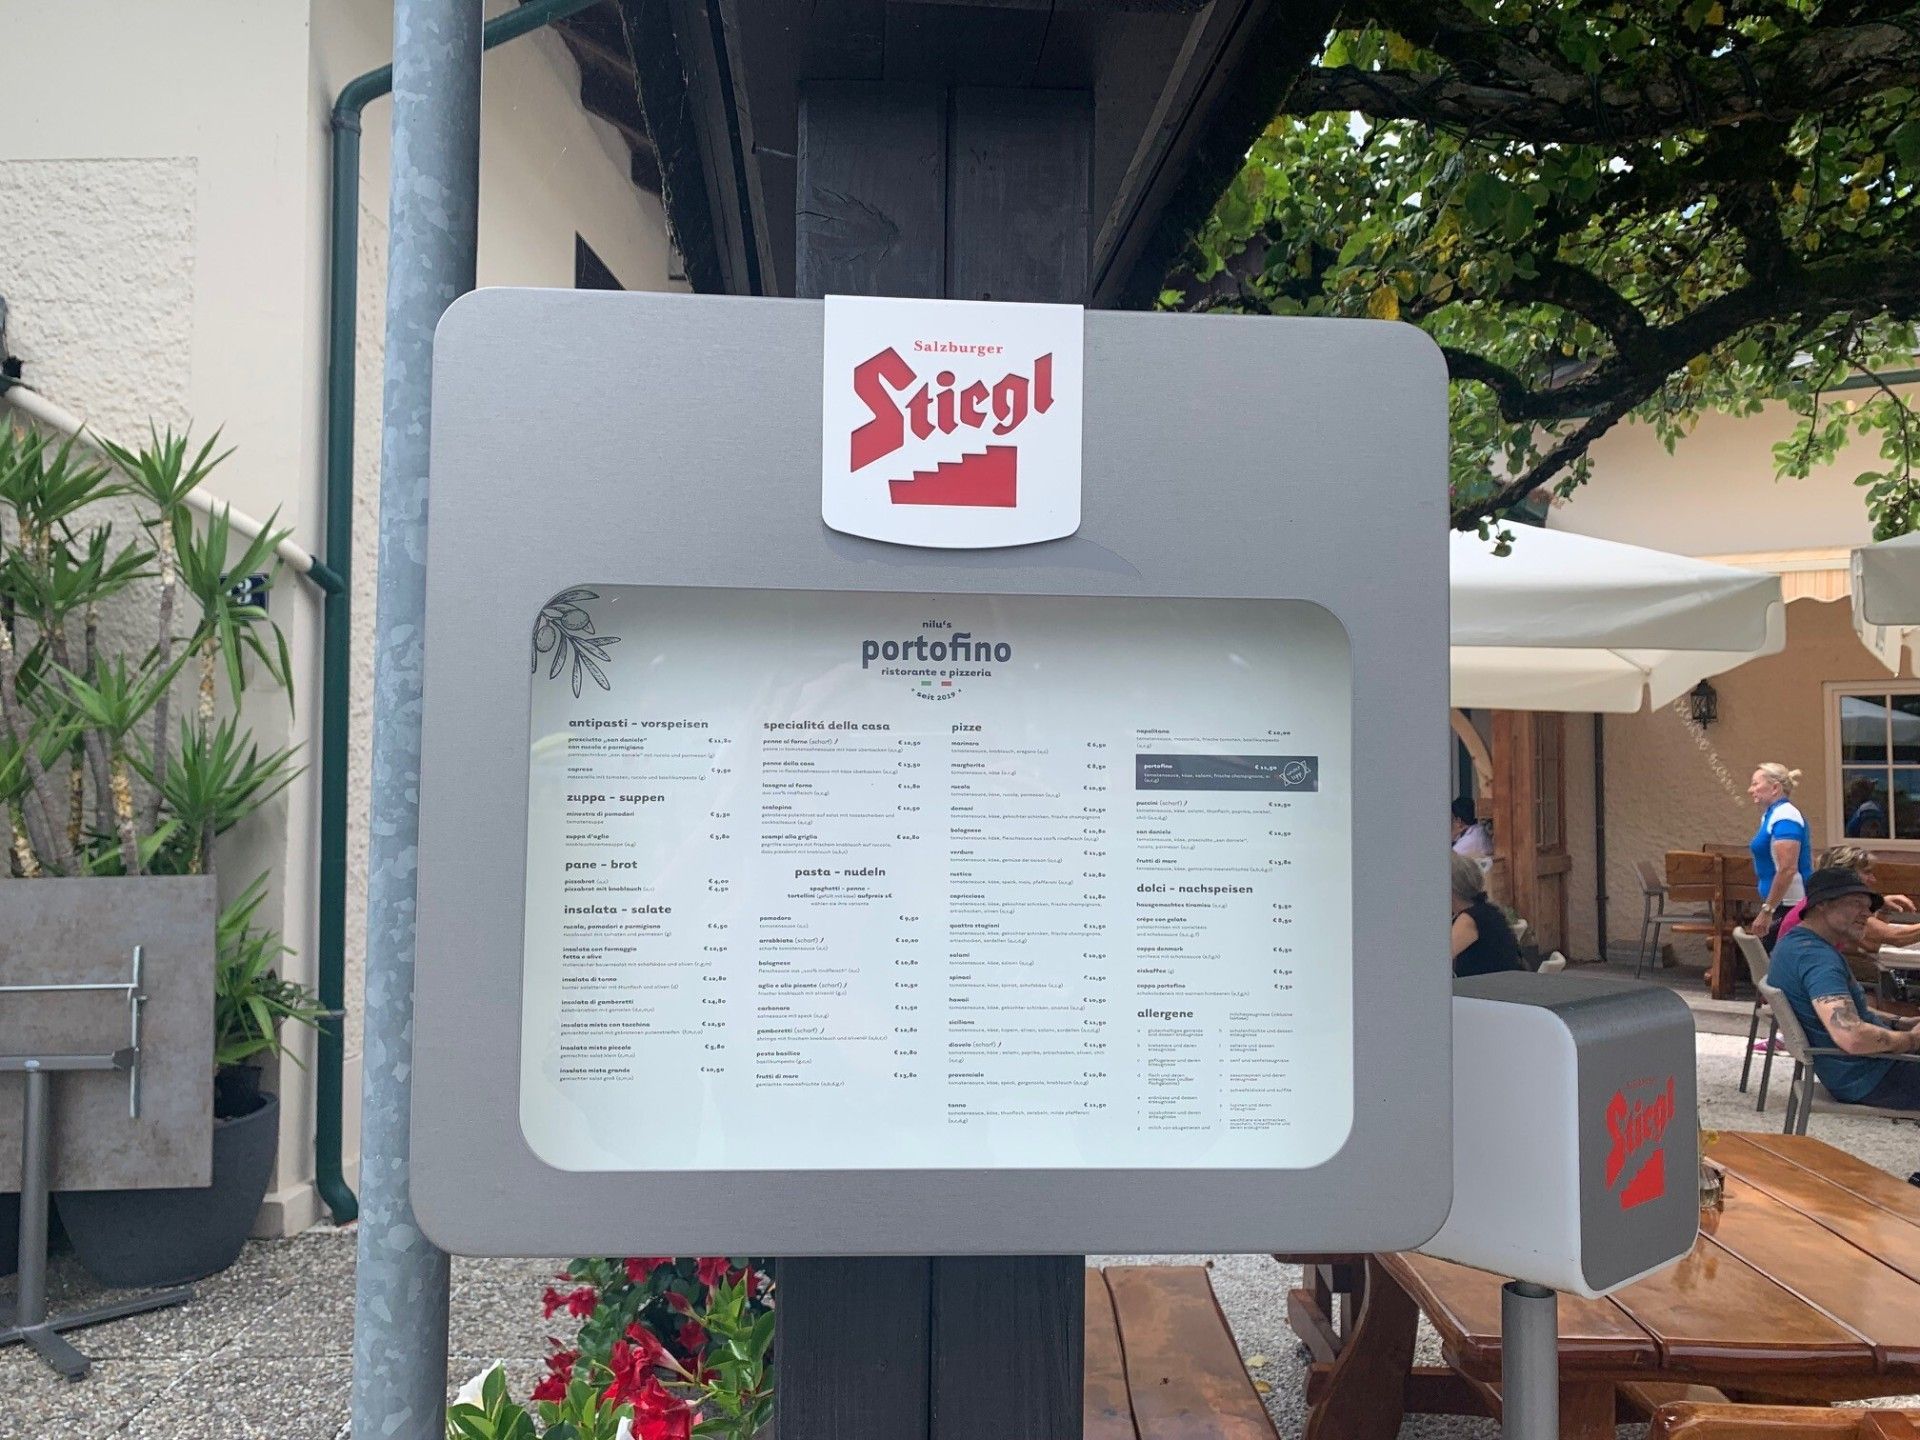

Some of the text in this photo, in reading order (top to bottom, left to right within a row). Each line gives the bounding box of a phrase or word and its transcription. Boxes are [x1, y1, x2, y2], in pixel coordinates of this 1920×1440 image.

[914, 340, 1004, 357] Salzburger
[850, 346, 1054, 473] Stiegl
[862, 632, 1012, 669] portofino
[882, 668, 936, 676] ristorante
[949, 668, 992, 678] pizzeria
[916, 692, 956, 700] seit 2019
[569, 718, 708, 731] antipasti vorspeisen
[828, 721, 858, 730] della
[952, 722, 982, 734] pizze
[567, 795, 665, 805] zuppa suppen
[565, 859, 638, 872] pane brot
[795, 867, 886, 879] pasta nudeln
[1136, 883, 1253, 896] dolci nachspeisen
[564, 904, 672, 914] insalata salate
[1137, 1008, 1194, 1021] allergene
